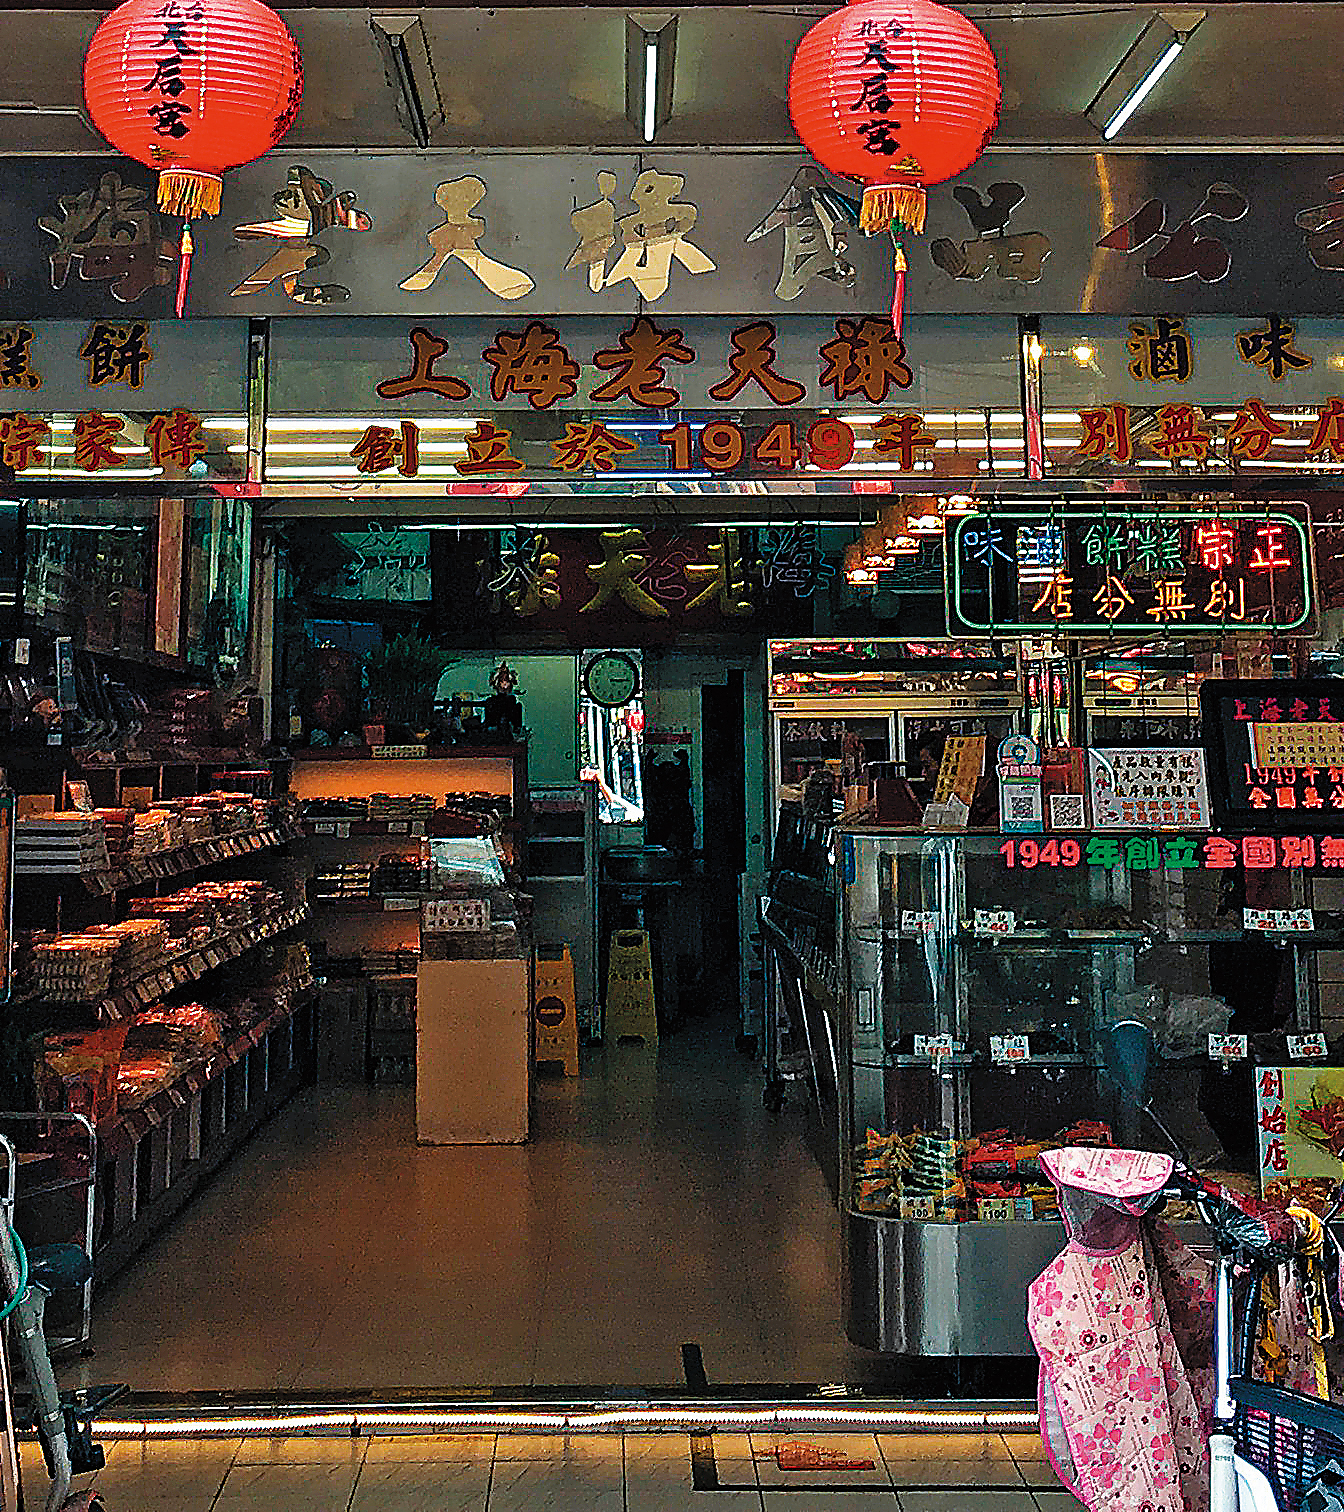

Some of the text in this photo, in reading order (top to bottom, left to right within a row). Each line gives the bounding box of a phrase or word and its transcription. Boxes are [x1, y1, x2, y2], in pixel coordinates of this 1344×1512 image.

[142, 22, 194, 140] 天后宮
[851, 39, 903, 158] 天后宮
[376, 316, 914, 409] 上海老天祿
